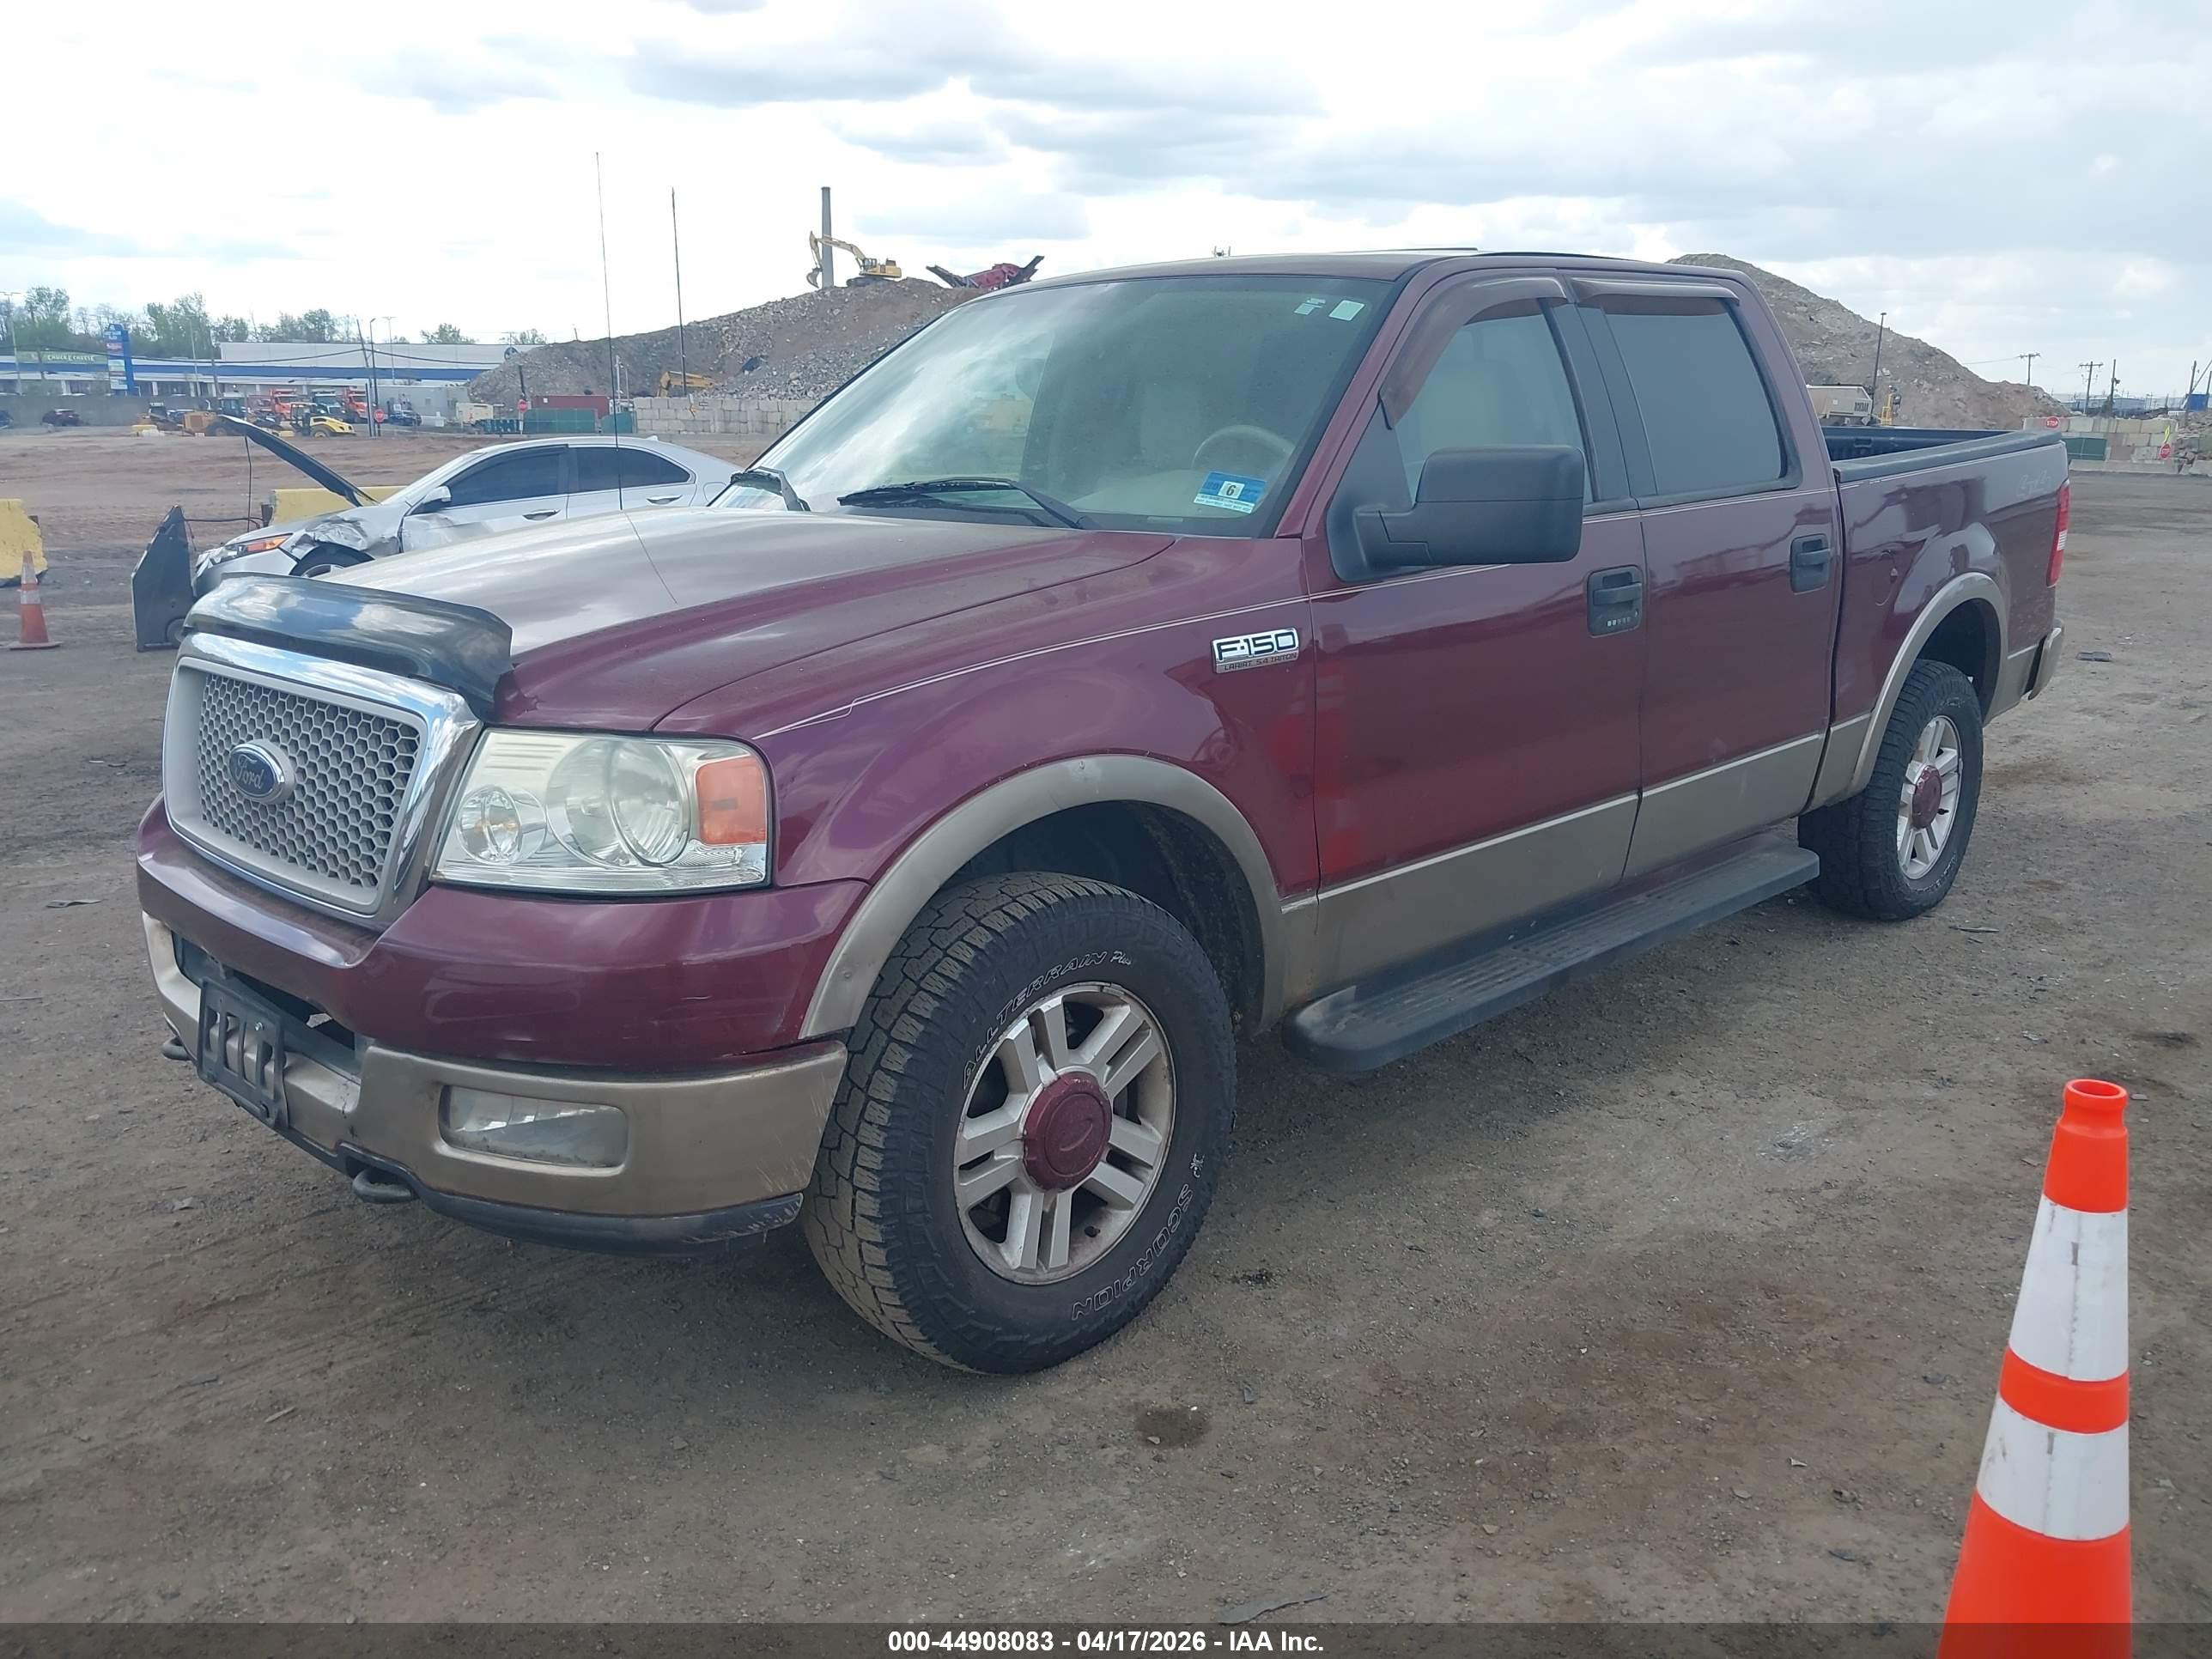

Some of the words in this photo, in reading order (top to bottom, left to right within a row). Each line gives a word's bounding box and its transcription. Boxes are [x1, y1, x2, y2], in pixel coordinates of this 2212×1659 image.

[1226, 484, 1237, 496] 6
[1224, 660, 1252, 671] LARIAT
[1271, 652, 1297, 663] TRITON
[234, 753, 265, 790] Ford
[963, 1026, 999, 1091] ALL
[996, 951, 1108, 1026] TERRAIN
[1071, 1182, 1194, 1322] SCORPION
